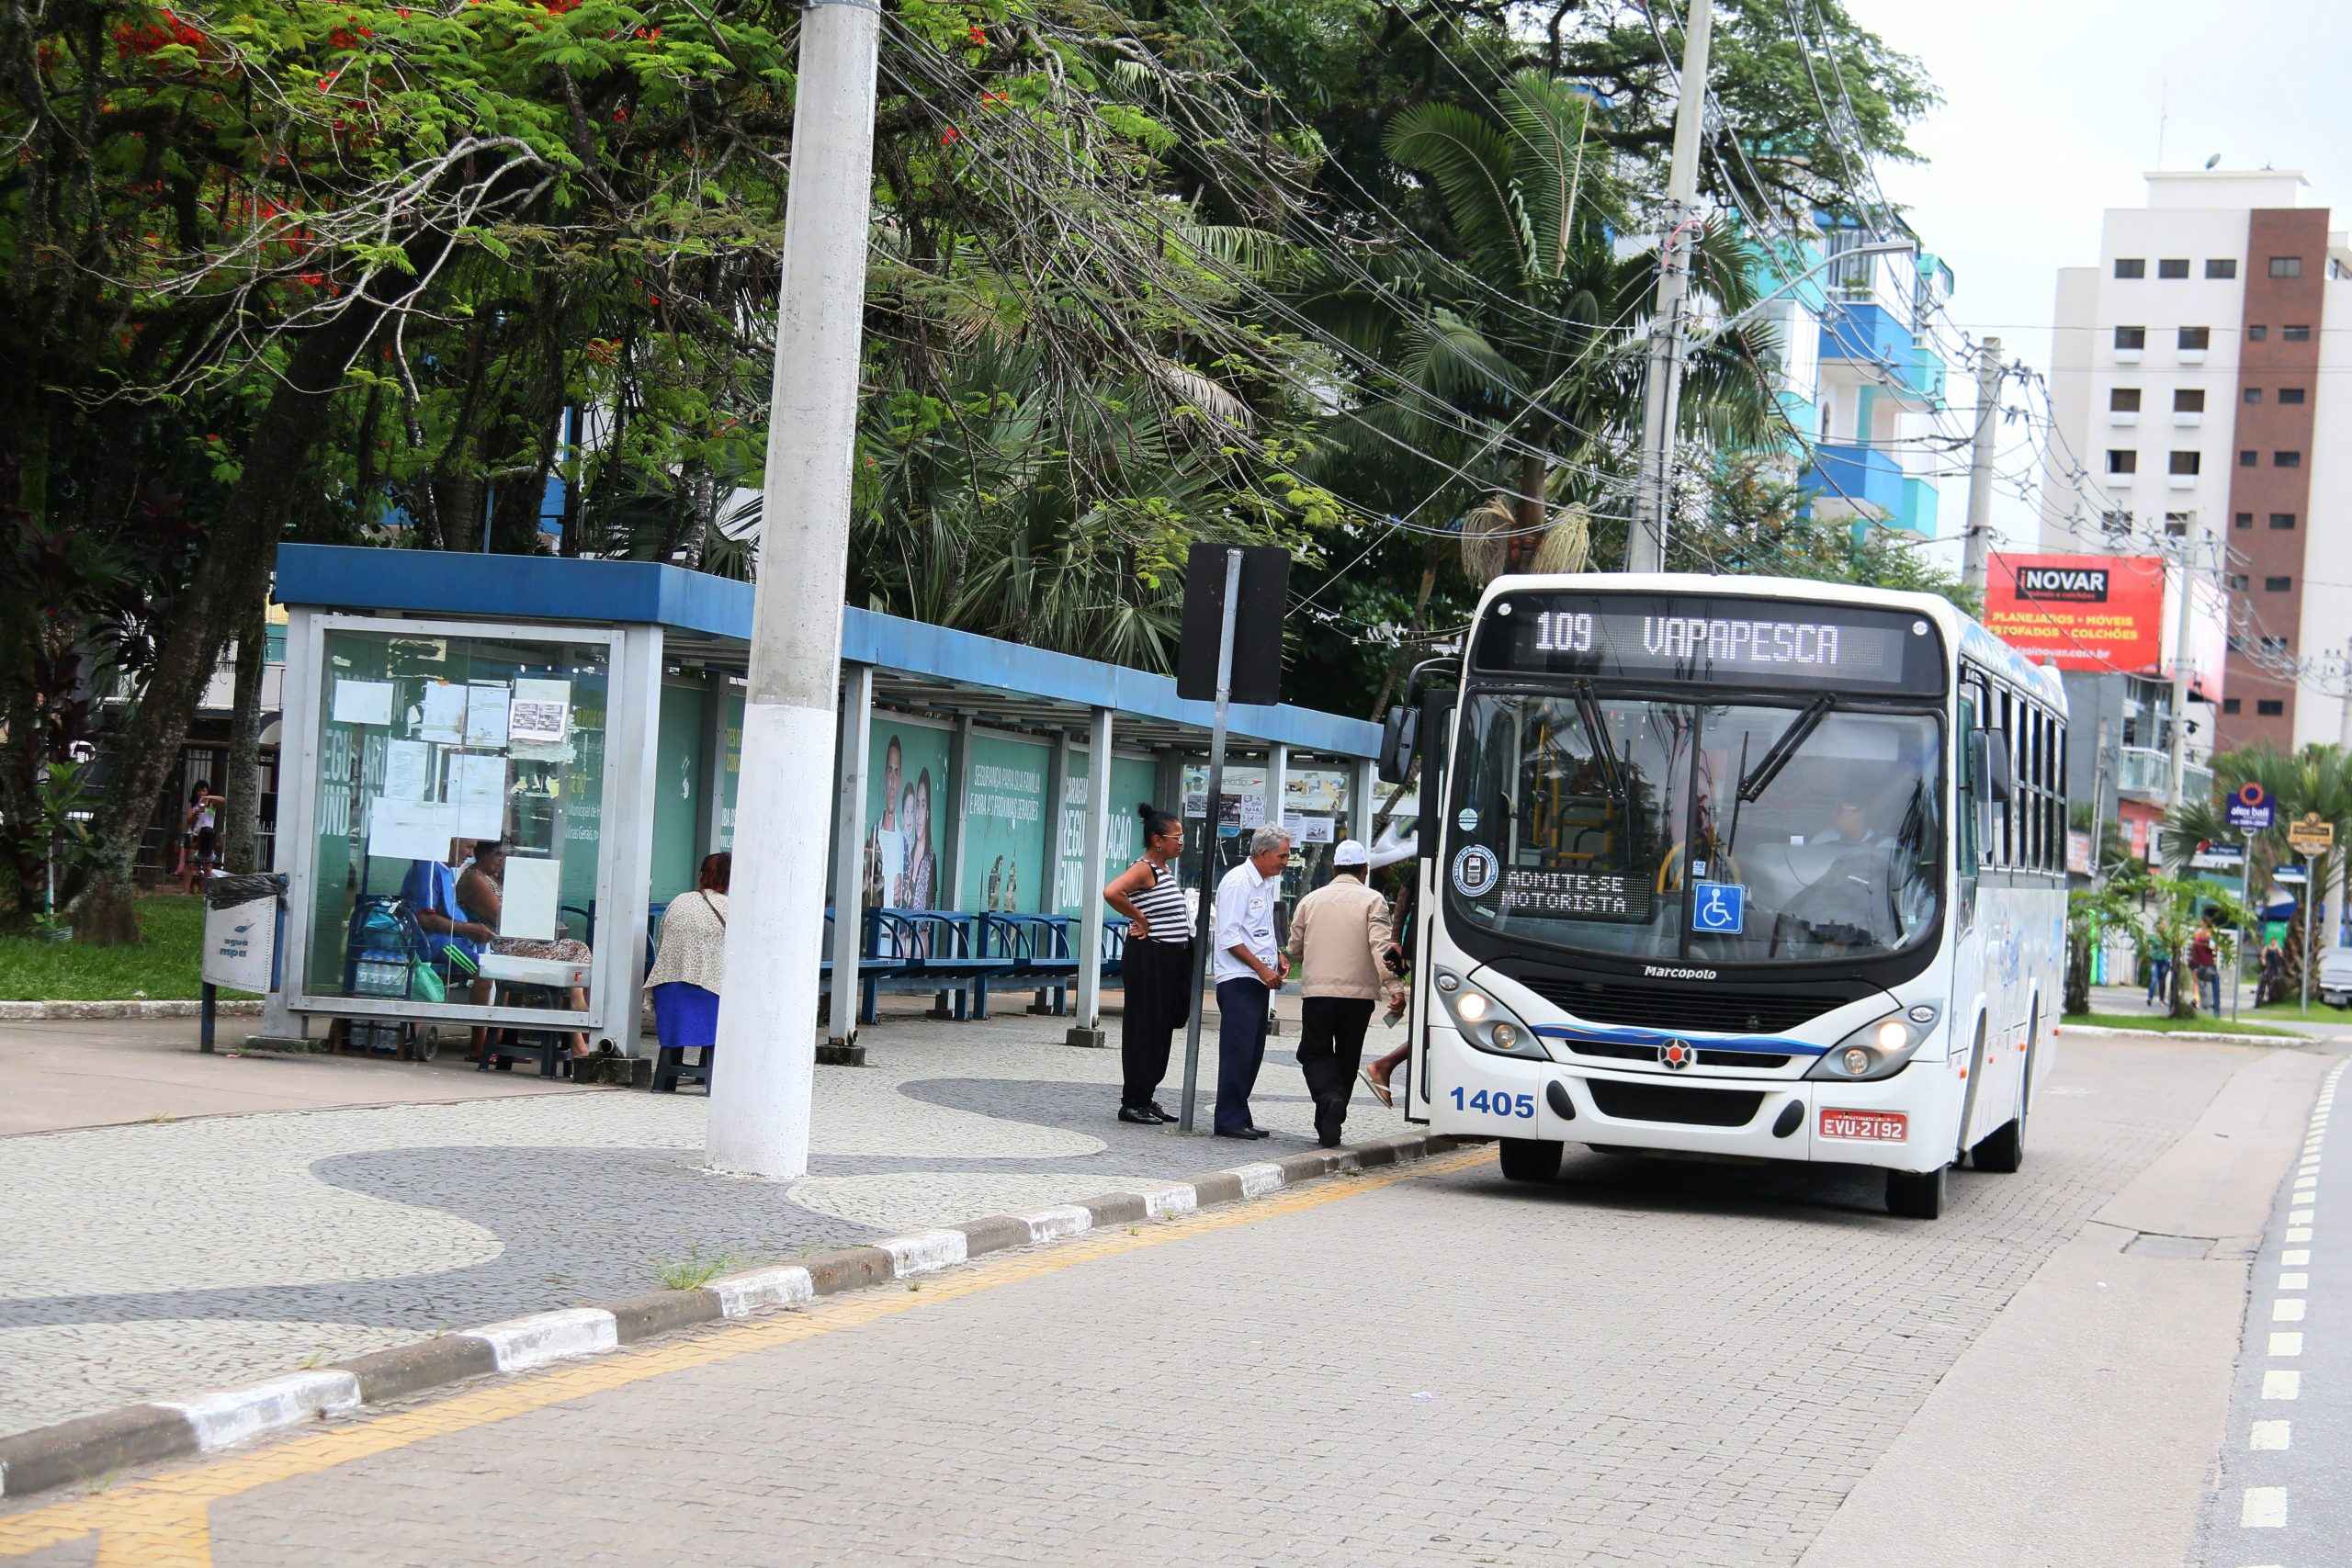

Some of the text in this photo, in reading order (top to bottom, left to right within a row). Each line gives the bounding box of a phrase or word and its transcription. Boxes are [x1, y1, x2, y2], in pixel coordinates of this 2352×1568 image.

[1992, 611, 2134, 626] PLANEJADOS MÓVEIS
[1535, 612, 1838, 664] 109 VAPAPESCA
[2071, 626, 2138, 640] COLCHÕES
[1507, 871, 1624, 892] ADMITE-SE
[1500, 890, 1626, 913] MOTORISTA
[1645, 965, 1717, 980] Marcopolo
[1450, 1086, 1534, 1119] 1405
